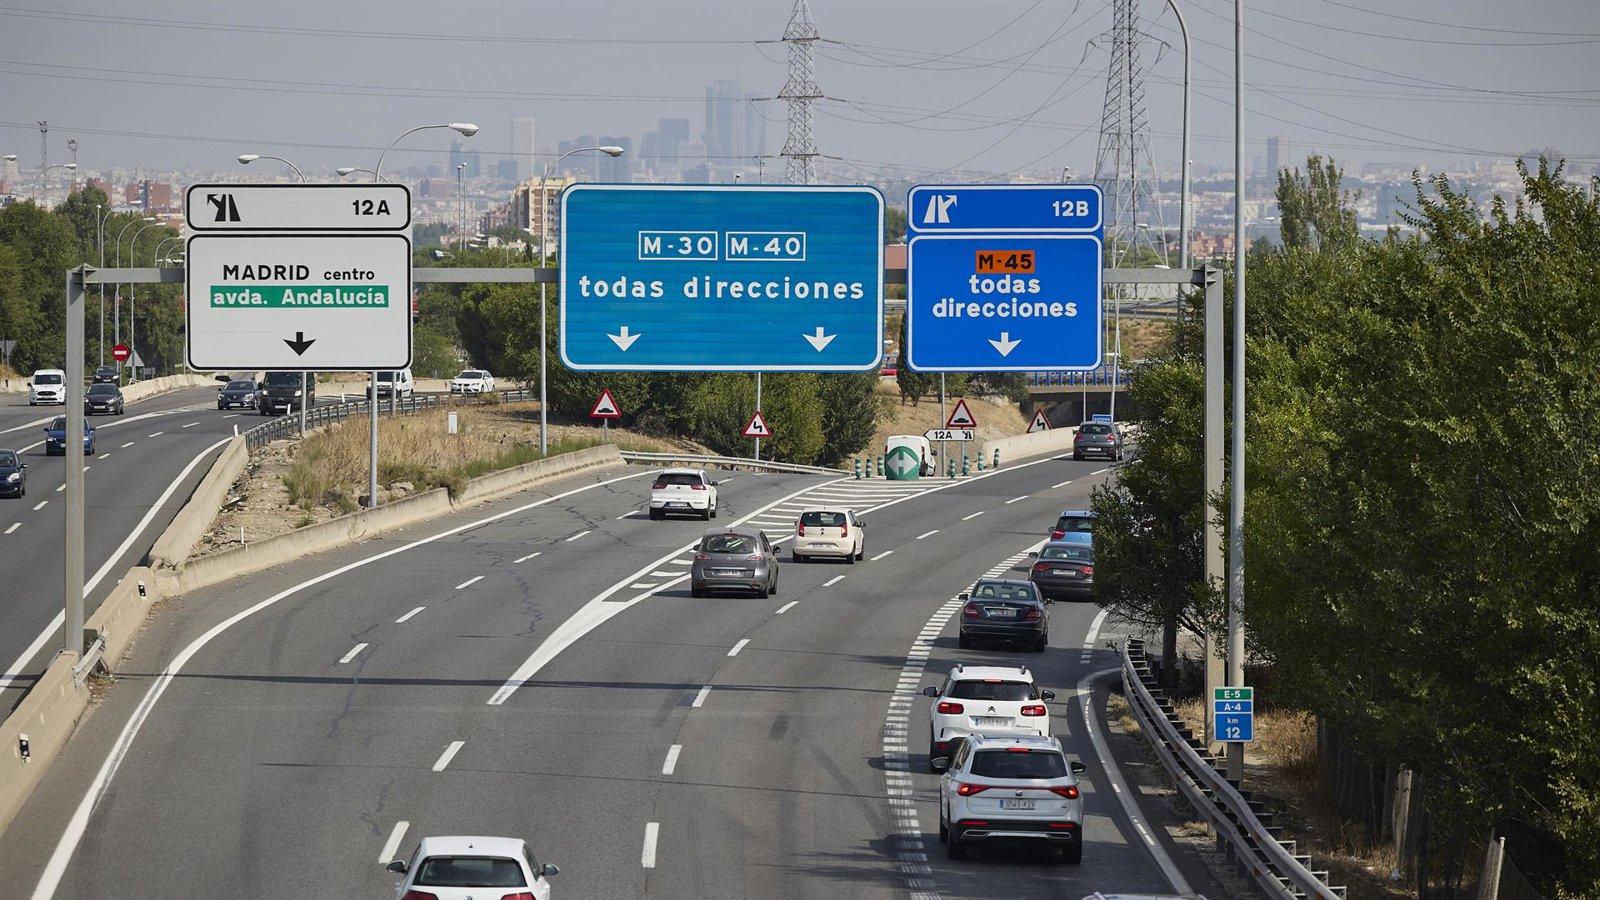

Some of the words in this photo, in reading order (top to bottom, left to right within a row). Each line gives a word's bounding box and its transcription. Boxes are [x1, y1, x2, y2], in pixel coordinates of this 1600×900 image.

[352, 199, 391, 216] 12A
[1052, 200, 1089, 217] 12B
[643, 236, 713, 255] M-30
[729, 236, 802, 256] M-40
[978, 253, 1032, 270] M-45
[223, 264, 310, 281] MADRID
[323, 268, 375, 281] centro
[578, 275, 664, 298] todas
[683, 275, 864, 299] direcciones
[968, 274, 1041, 294] todas
[213, 288, 268, 306] avda.
[281, 287, 386, 306] Andalucía
[932, 297, 1078, 318] direcciones
[934, 430, 953, 439] 12A
[1224, 690, 1241, 698] E-5
[1224, 703, 1241, 711] A-4
[1226, 727, 1240, 738] 12
